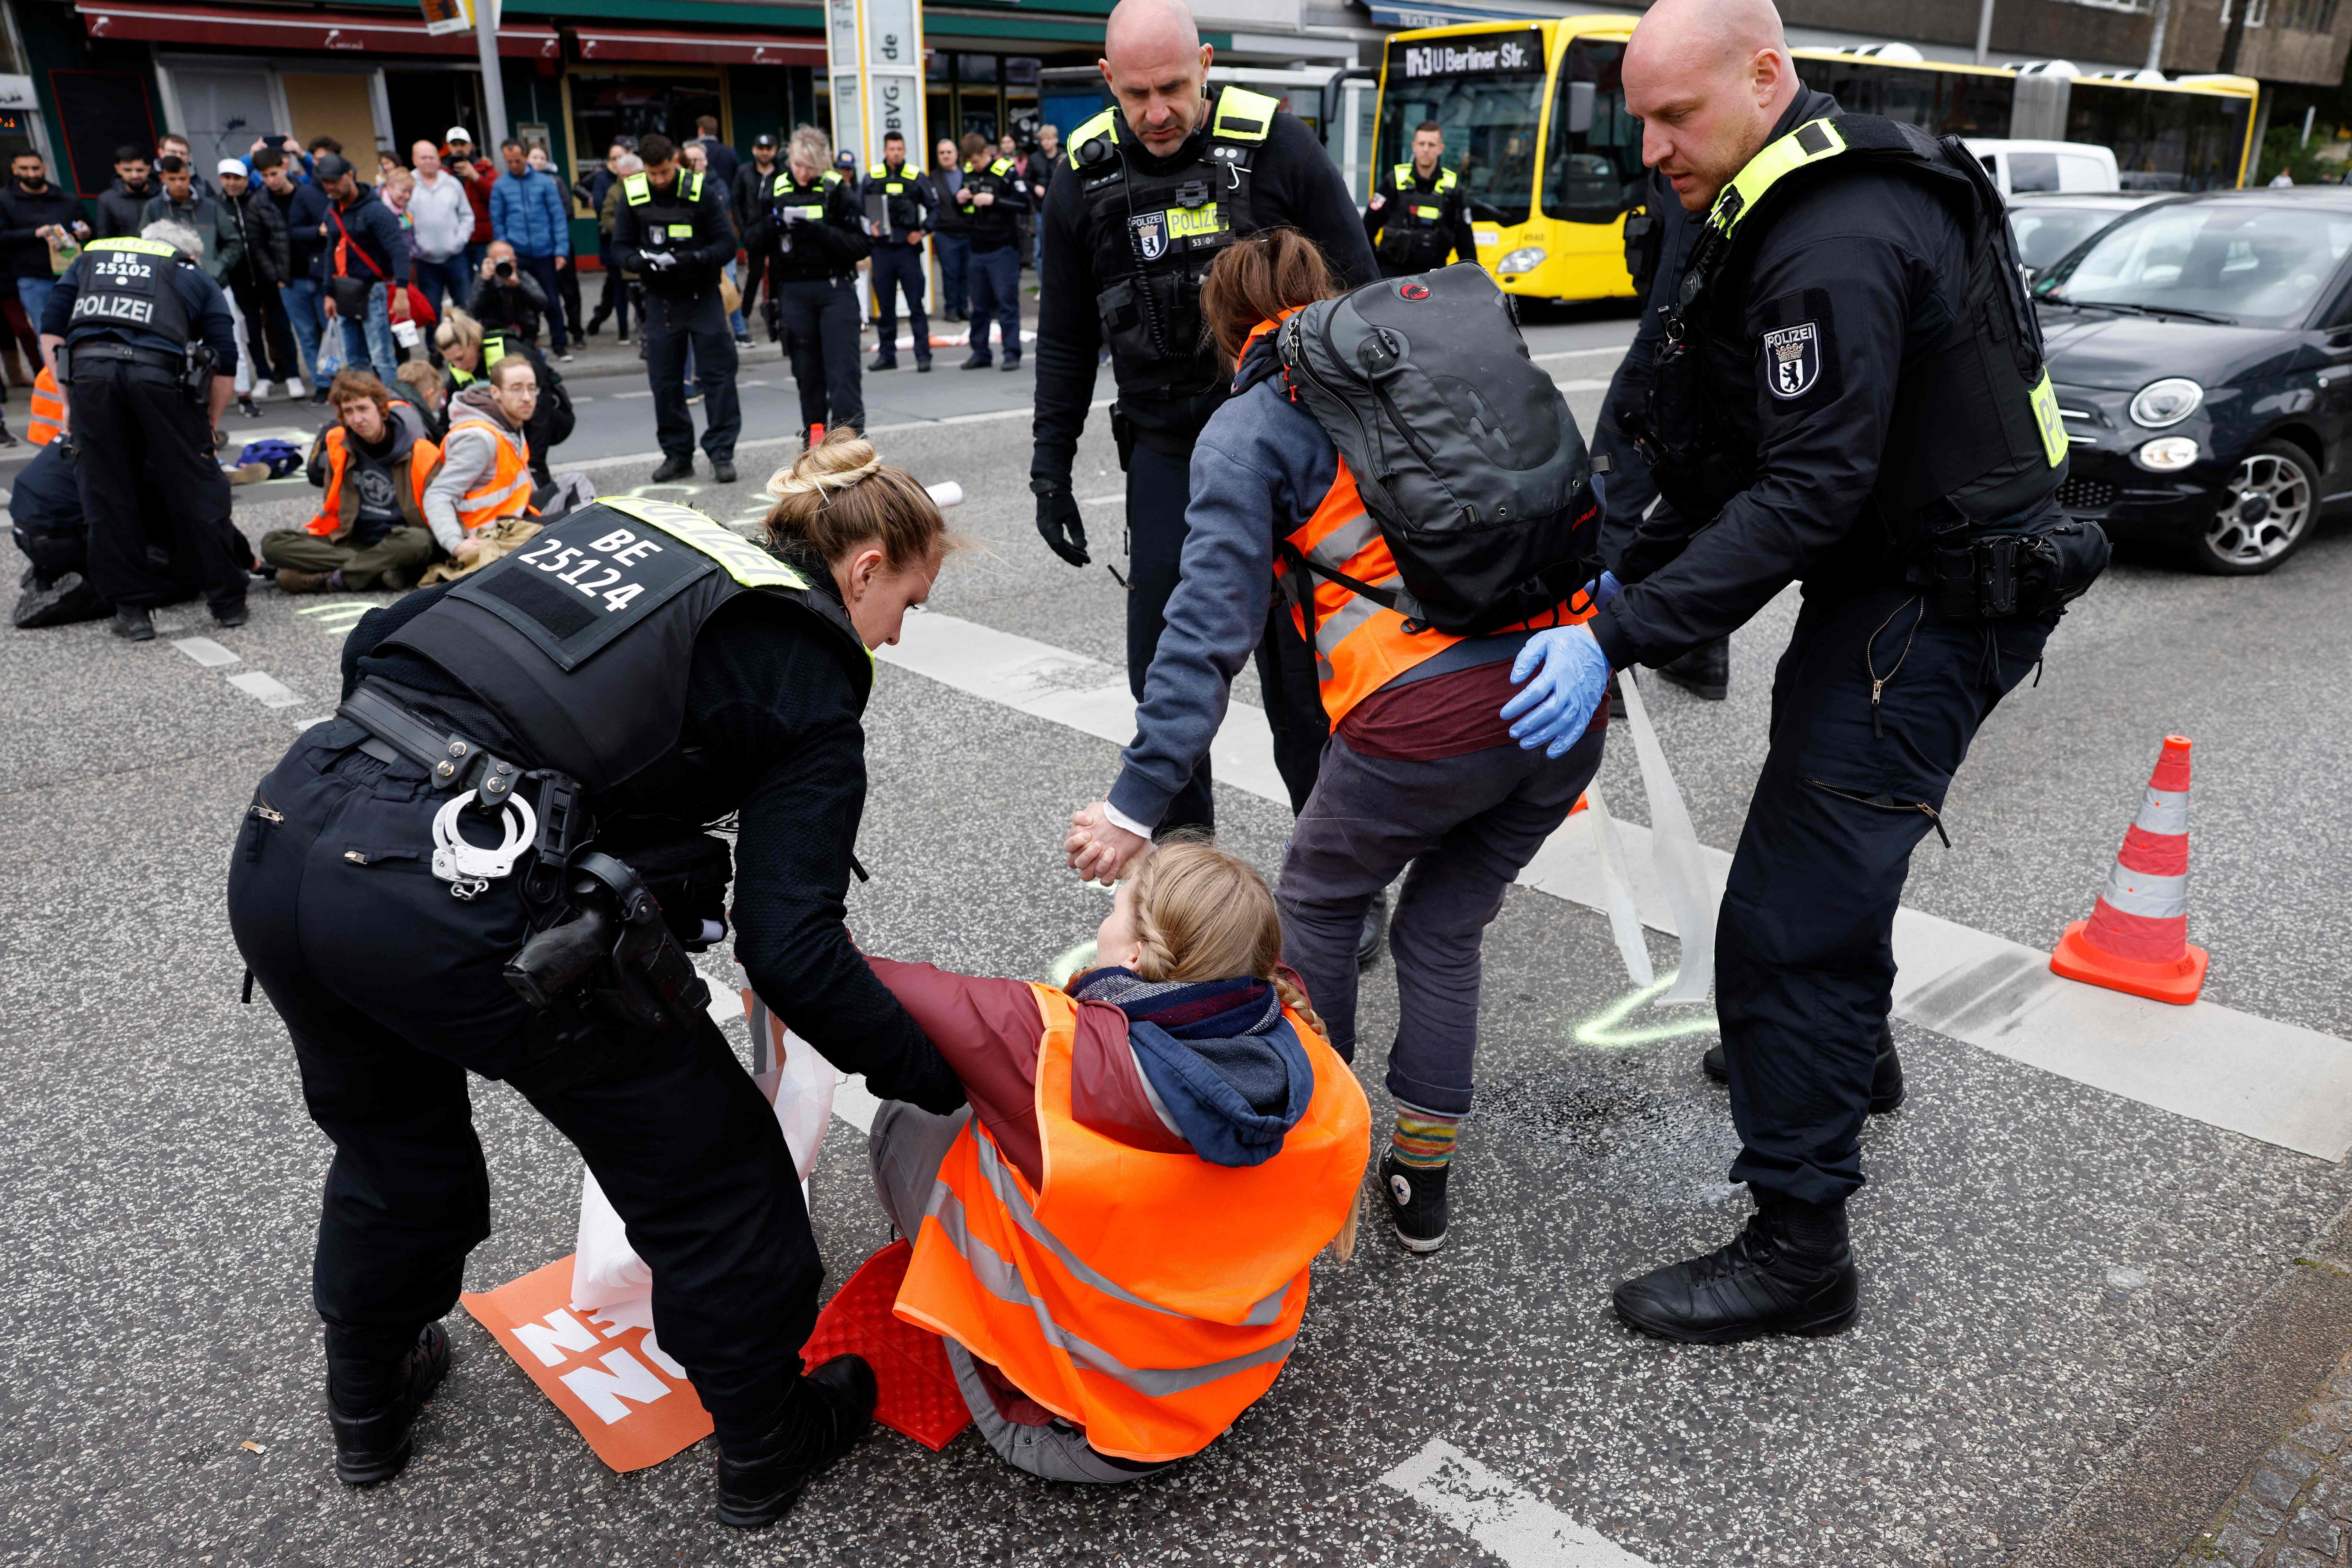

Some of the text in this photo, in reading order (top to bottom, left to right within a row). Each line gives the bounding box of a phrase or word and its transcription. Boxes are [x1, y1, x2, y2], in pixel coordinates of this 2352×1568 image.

[1432, 48, 1444, 73] U
[1445, 45, 1499, 72] Berliner
[1500, 42, 1528, 68] Str.
[1131, 215, 1162, 227] POLIZEI
[1171, 209, 1218, 232] POLIZE
[95, 262, 151, 278] 25102
[112, 252, 138, 264] BE
[72, 295, 154, 324] POLIZEI
[1767, 326, 1812, 348] POLIZEI
[588, 528, 663, 567] BE
[613, 497, 791, 578] POLIZEI
[517, 538, 645, 612] 25124
